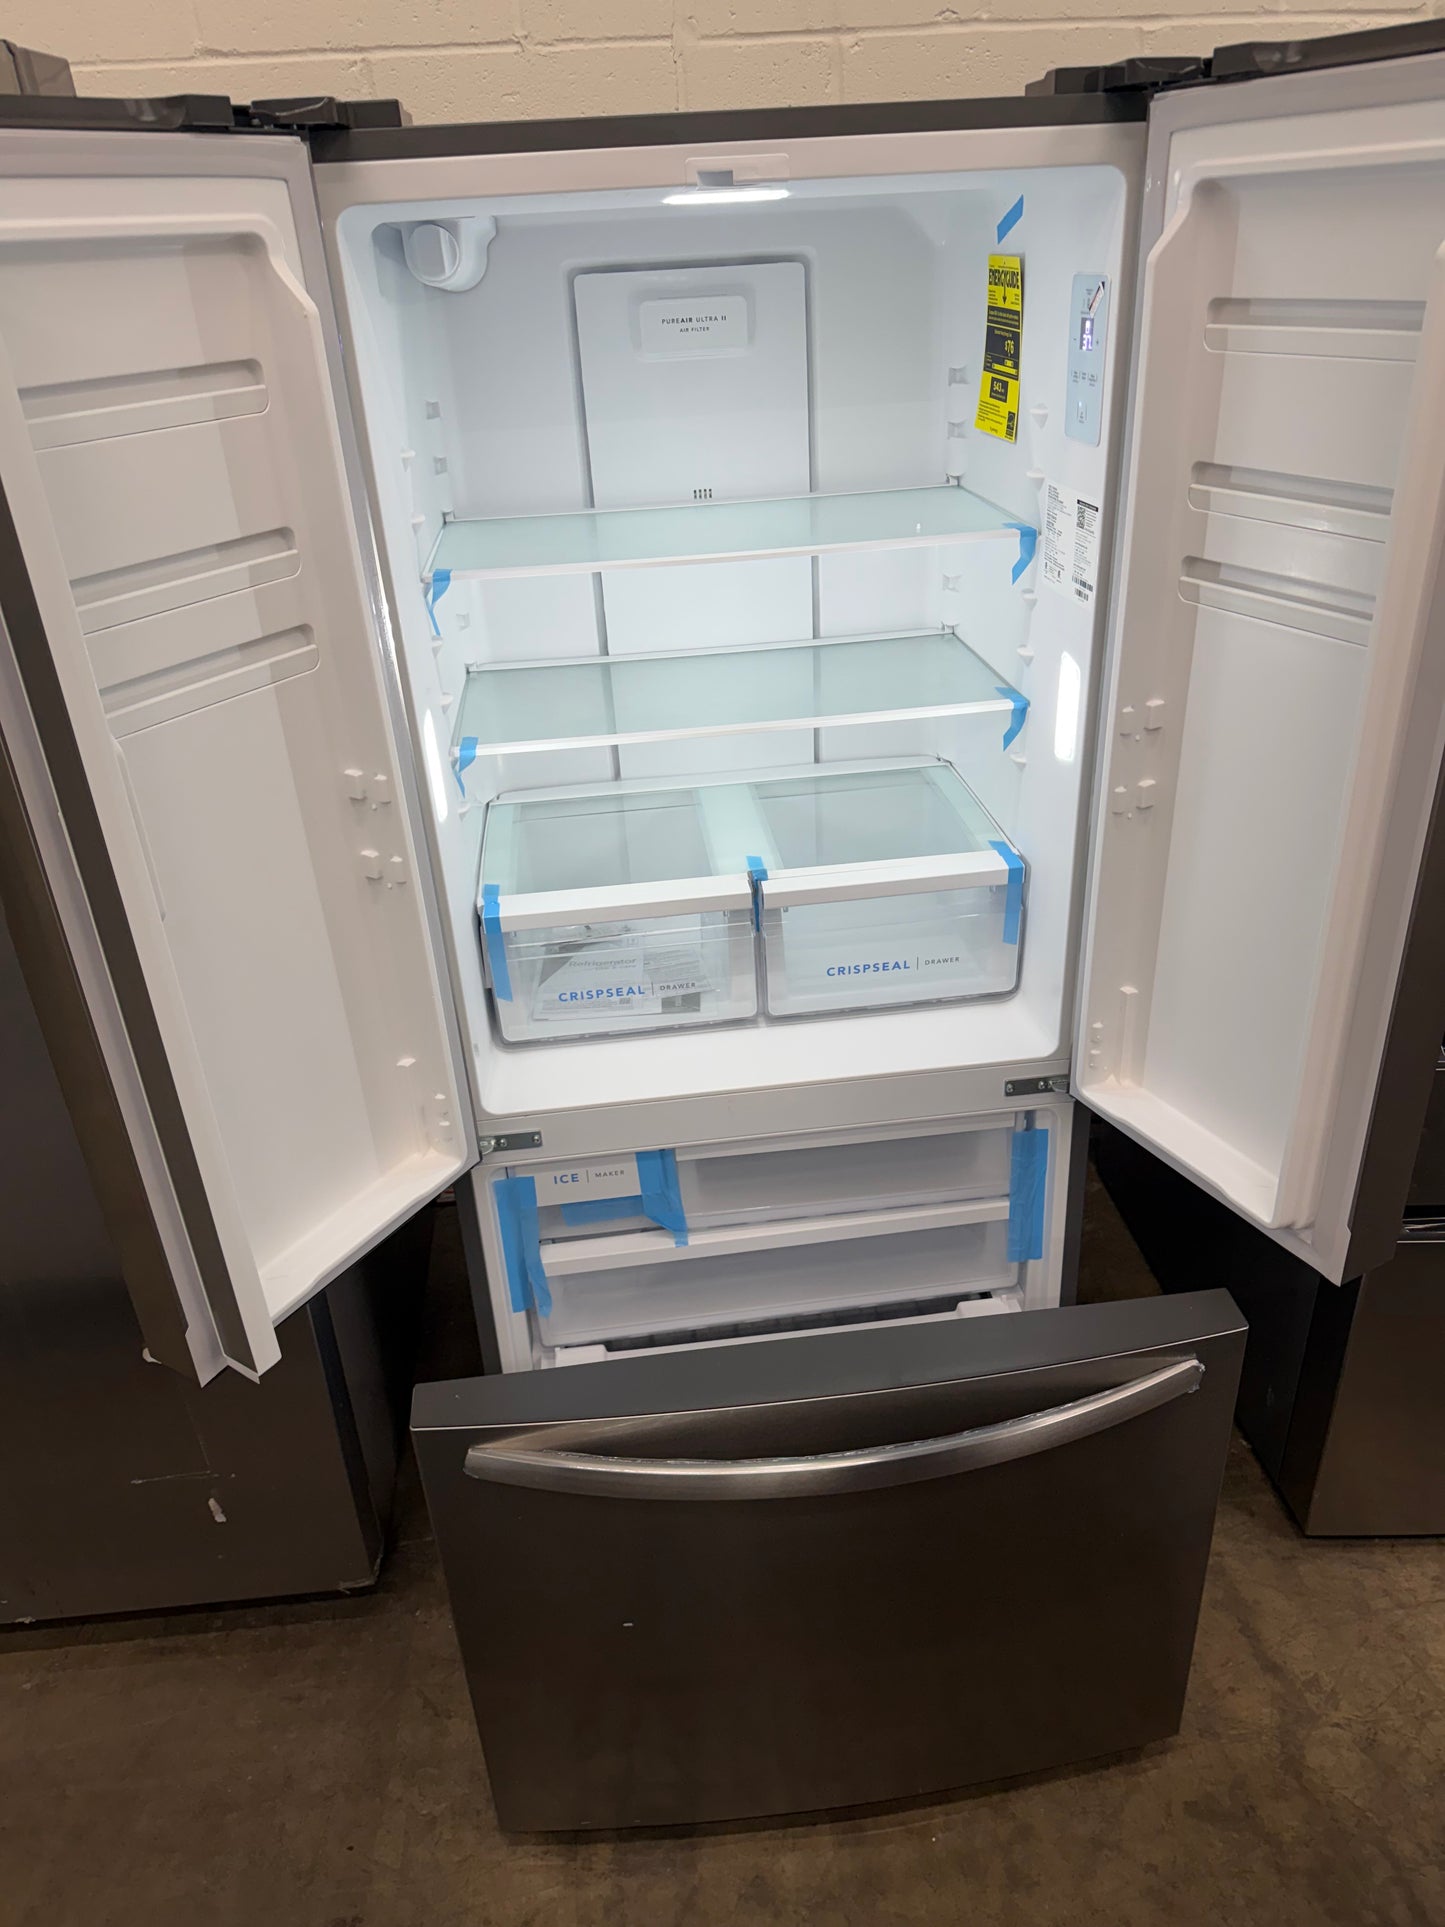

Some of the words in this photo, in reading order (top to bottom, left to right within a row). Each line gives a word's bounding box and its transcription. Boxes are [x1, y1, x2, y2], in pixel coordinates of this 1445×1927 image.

[569, 958, 637, 968] Refrigerator
[826, 960, 911, 977] CRISPSEAL
[924, 956, 960, 966] DRAWER
[558, 985, 646, 1002] CRISPSEAL
[659, 982, 696, 991] DRAWER
[553, 1173, 580, 1185] ICE
[595, 1169, 625, 1178] MAKER
